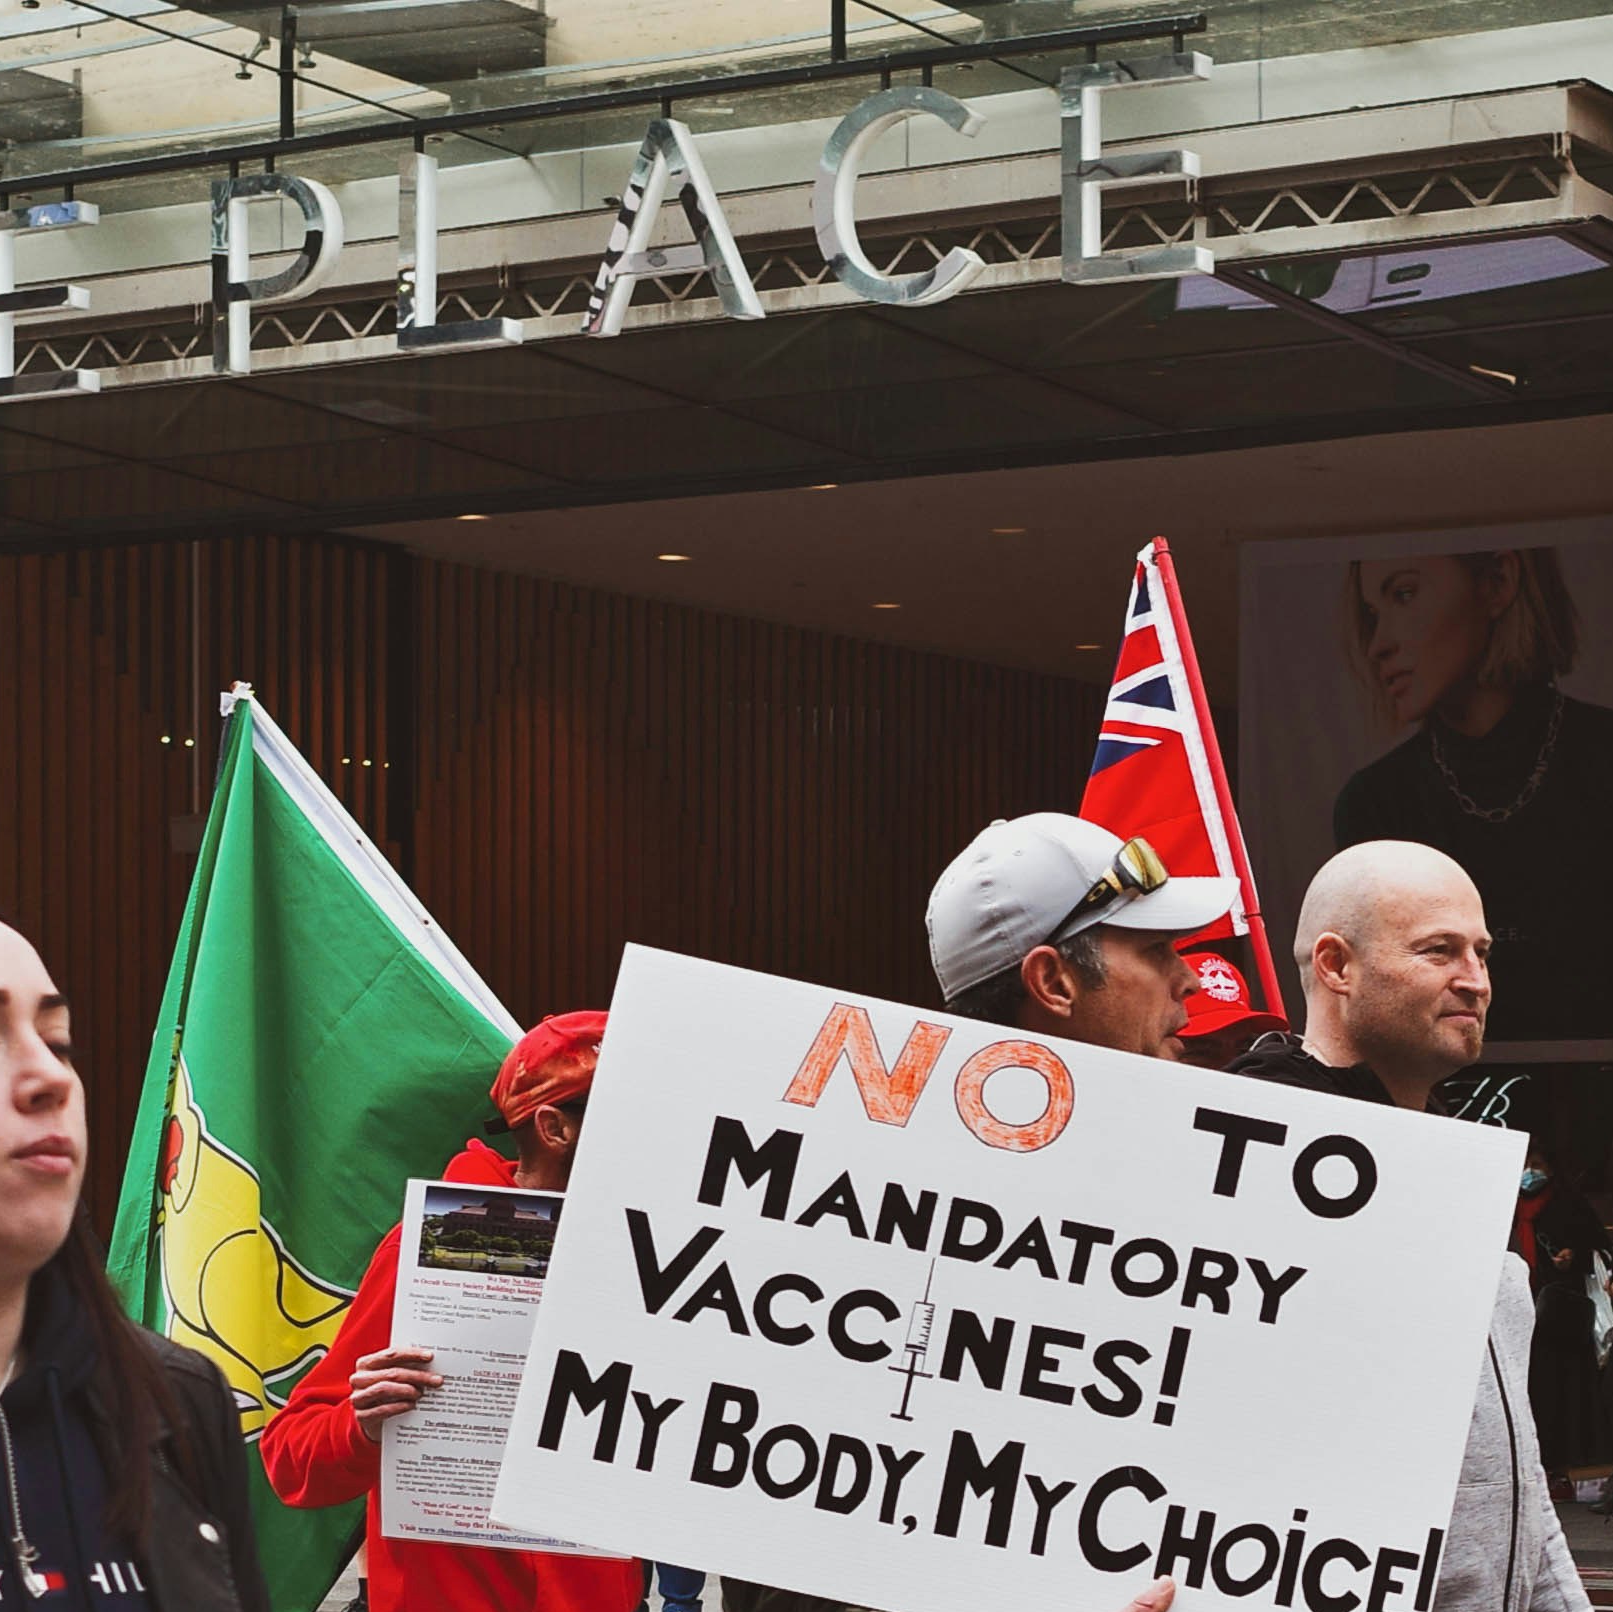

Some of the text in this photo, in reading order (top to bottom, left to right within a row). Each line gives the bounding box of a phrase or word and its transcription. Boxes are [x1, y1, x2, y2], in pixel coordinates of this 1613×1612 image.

[211, 50, 1215, 376] PLACE
[784, 1002, 1377, 1219] NO TO
[696, 1115, 1306, 1325] MANDATORY
[692, 1383, 925, 1536] BODY,
